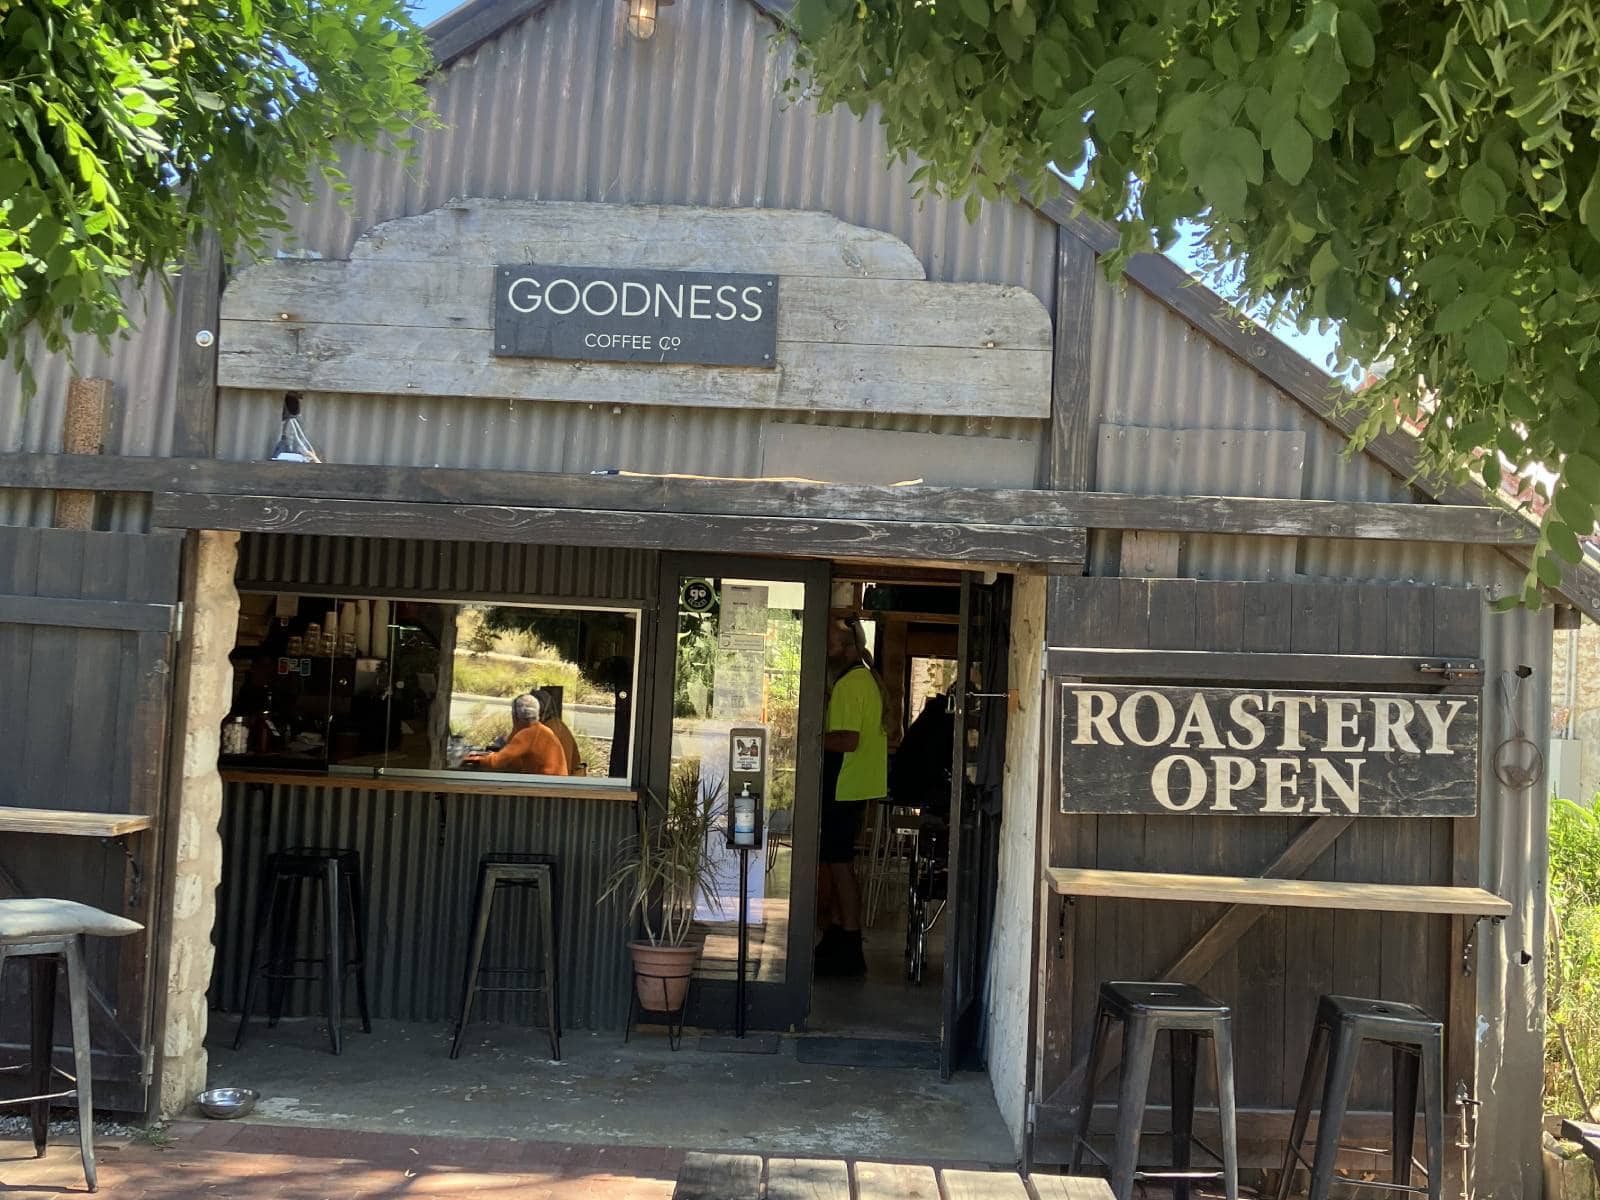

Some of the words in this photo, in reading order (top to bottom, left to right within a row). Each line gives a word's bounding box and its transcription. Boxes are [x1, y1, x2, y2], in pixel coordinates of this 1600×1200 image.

[508, 277, 762, 321] GOODNESS
[585, 333, 651, 350] COFFEE
[1071, 690, 1467, 755] ROASTERY
[1151, 755, 1366, 813] OPEN
